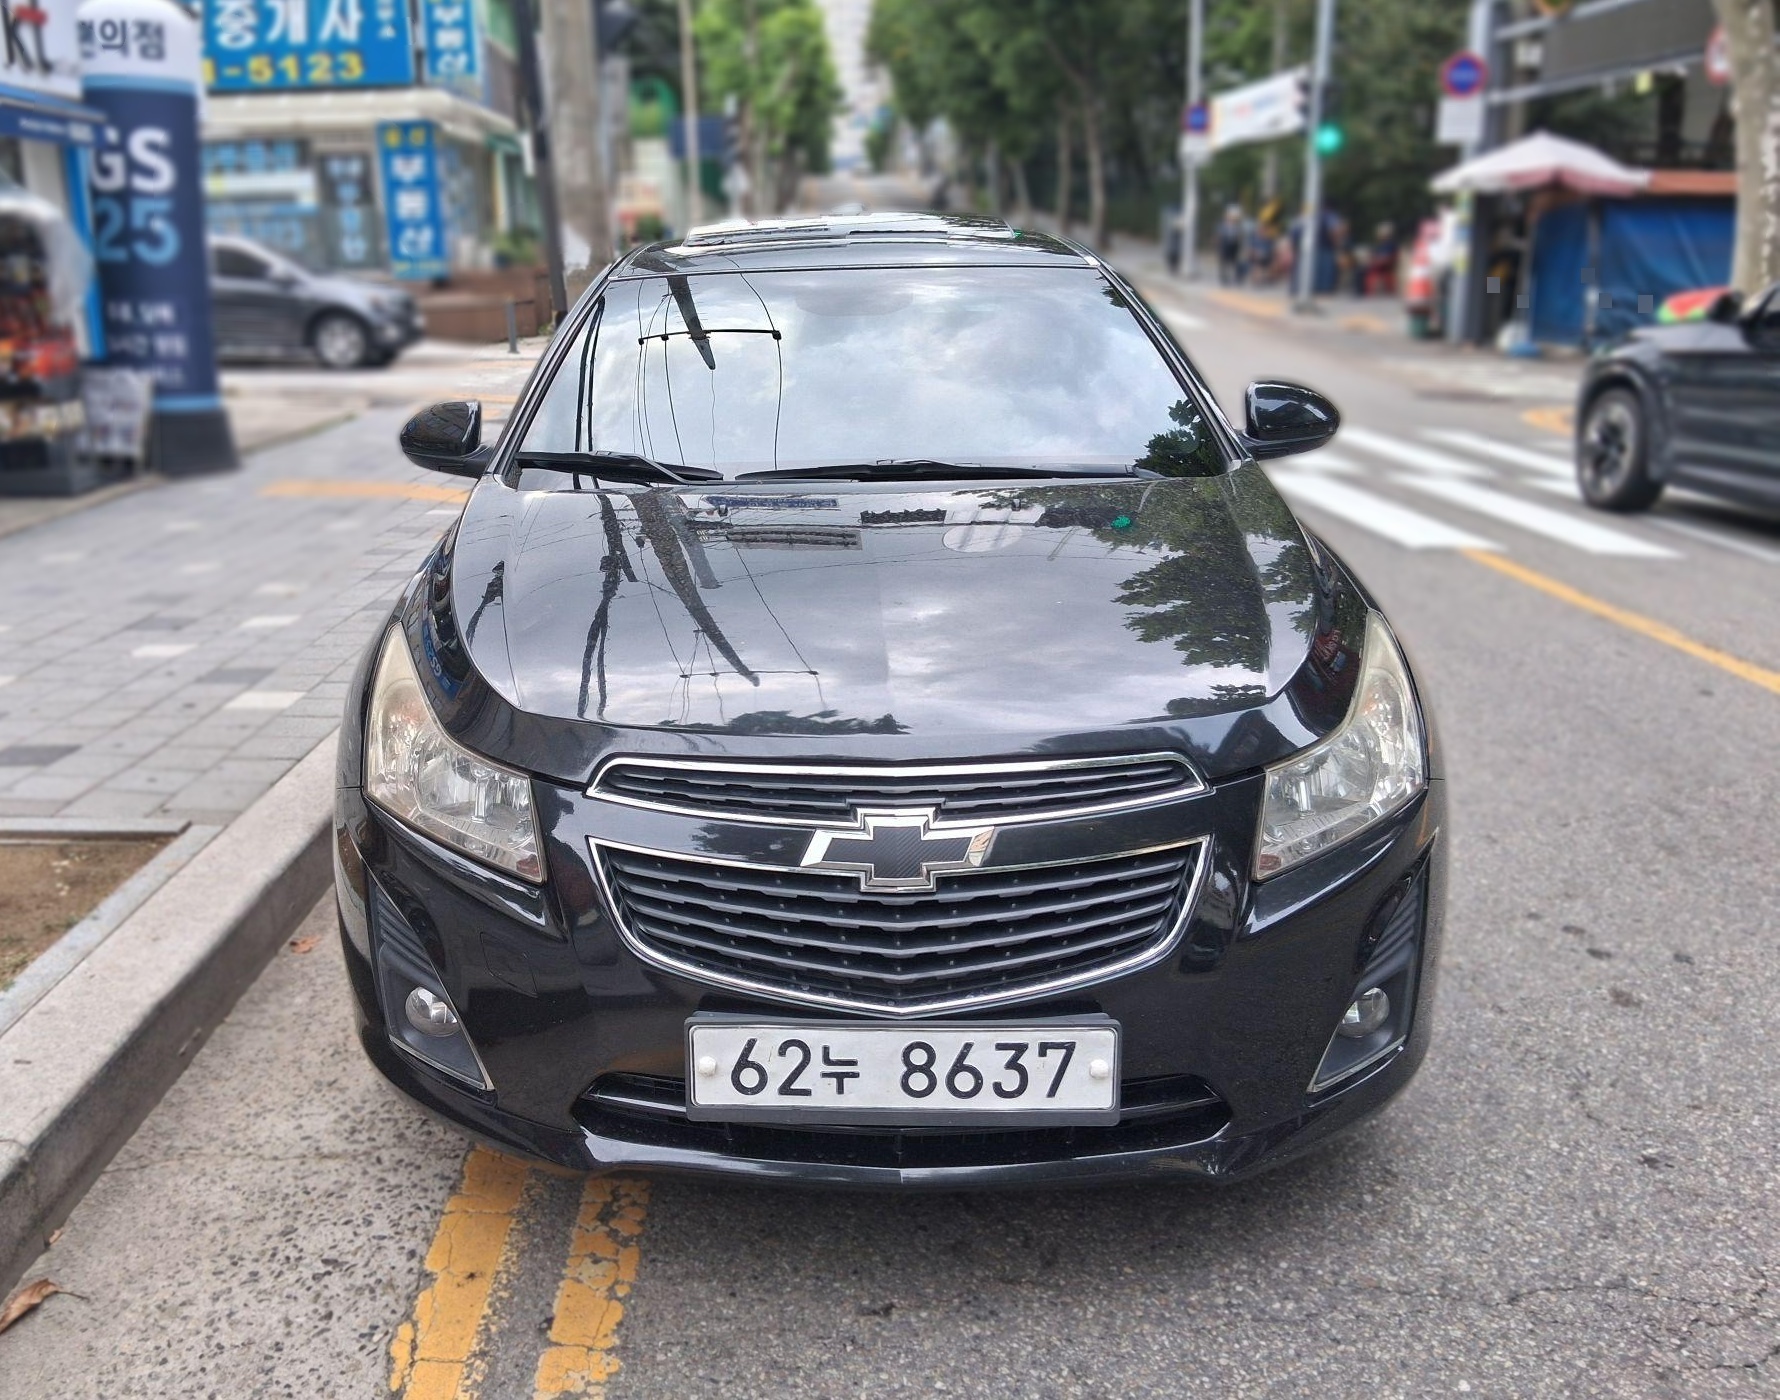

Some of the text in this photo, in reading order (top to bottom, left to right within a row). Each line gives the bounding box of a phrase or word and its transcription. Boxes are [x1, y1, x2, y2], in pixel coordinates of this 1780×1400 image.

[91, 126, 176, 192] GS
[94, 197, 182, 266] 25
[730, 1037, 1077, 1100] 62누 8637
